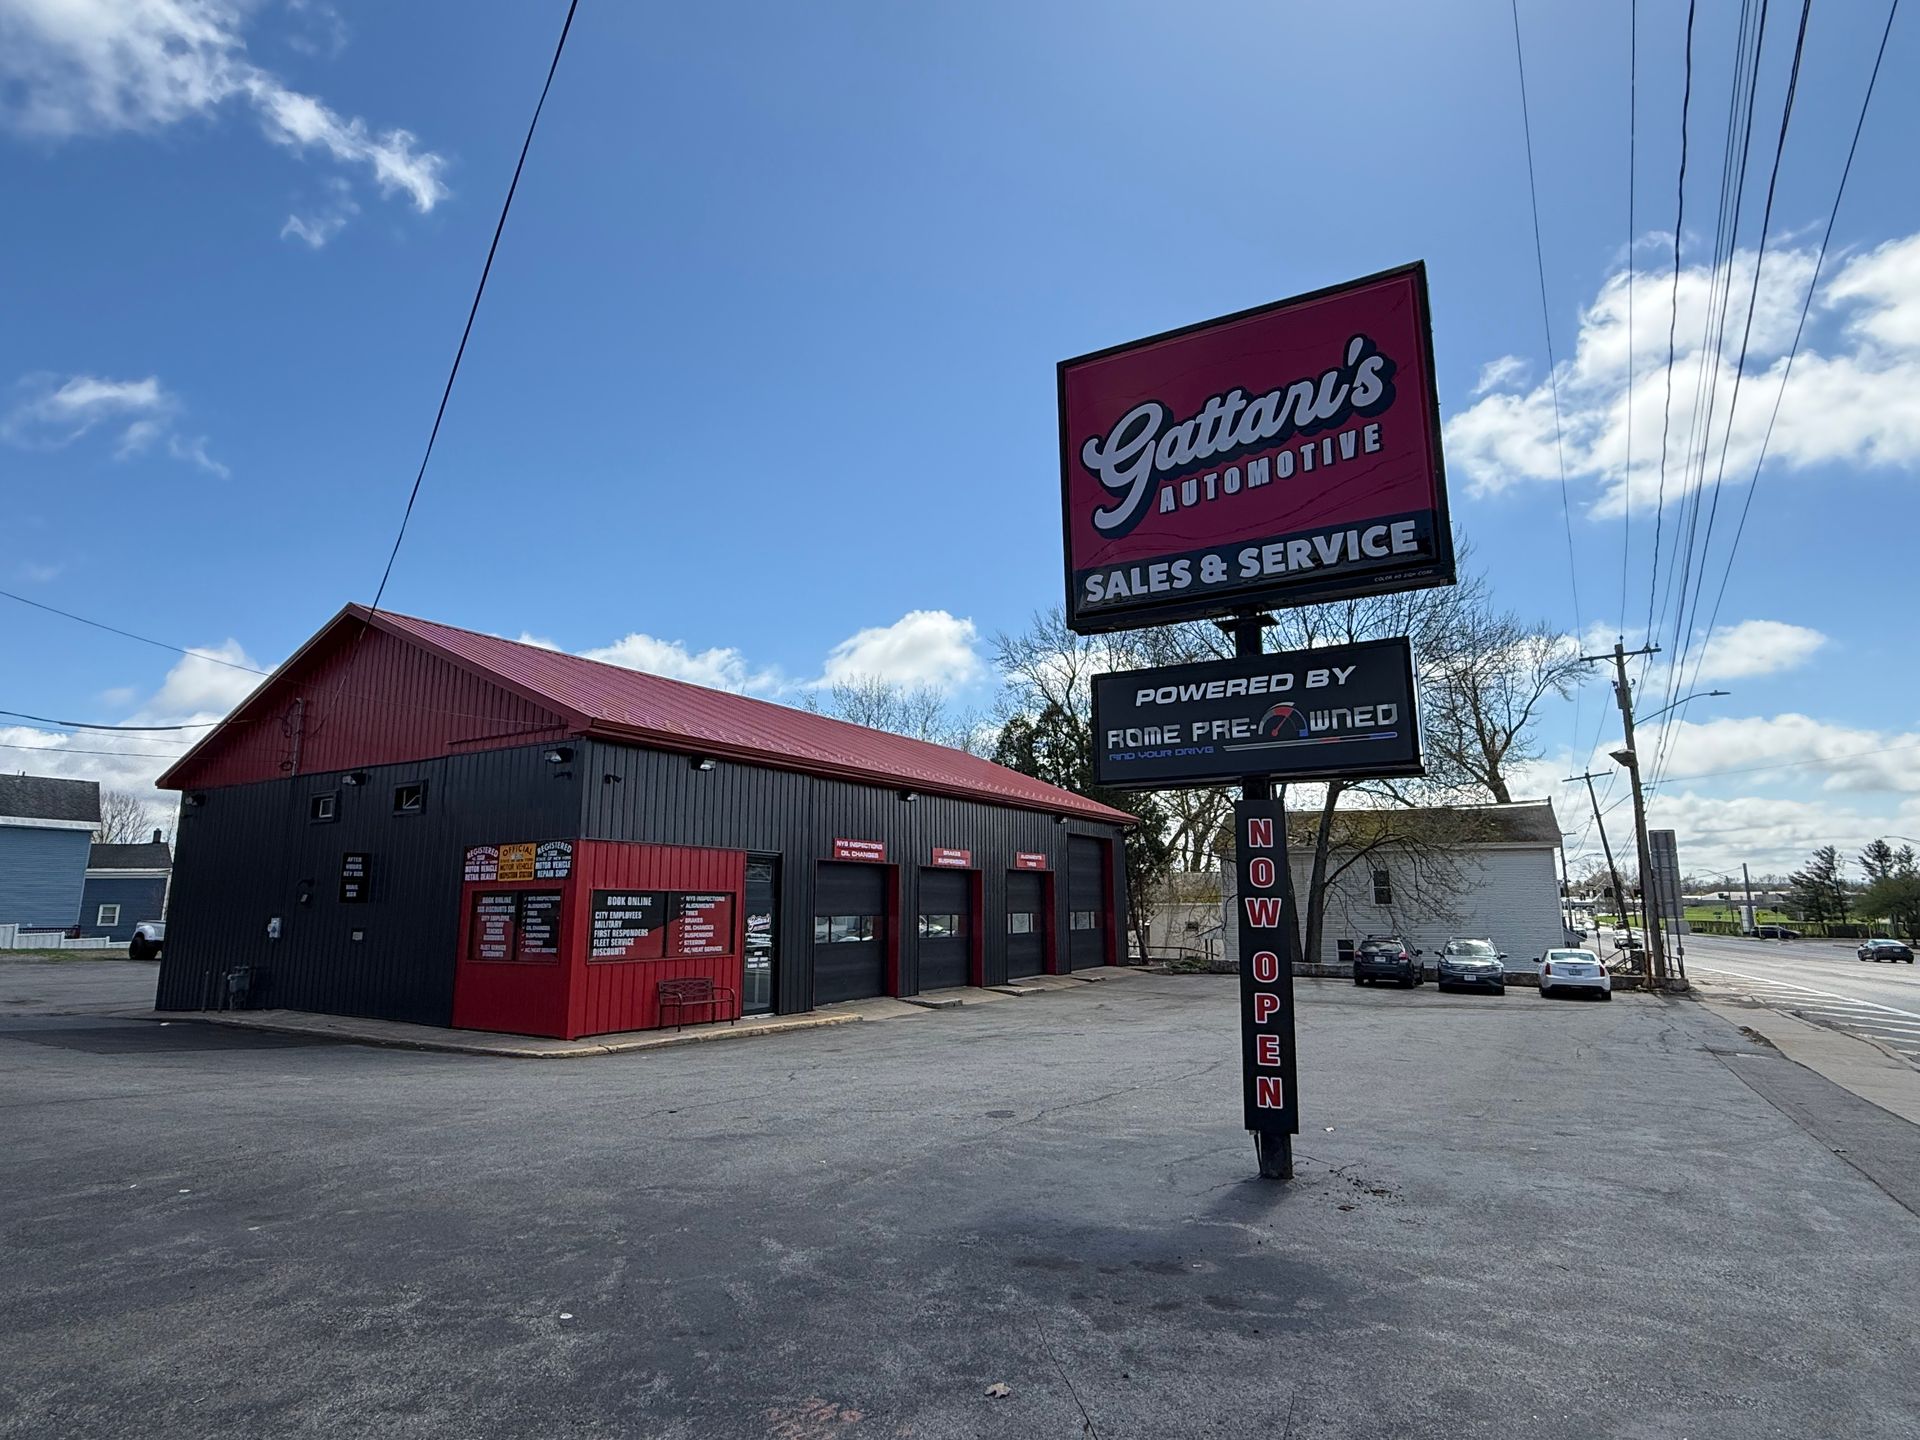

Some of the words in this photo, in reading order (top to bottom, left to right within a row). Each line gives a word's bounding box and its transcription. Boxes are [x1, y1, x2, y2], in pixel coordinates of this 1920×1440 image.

[1158, 422, 1382, 514] AUTOMOTIVE
[1085, 558, 1193, 602] SALES
[1199, 553, 1228, 583] &
[1238, 519, 1418, 579] SERVICE
[1135, 672, 1294, 707] POWERED
[1305, 665, 1357, 689] BY
[1107, 724, 1181, 749] ROME
[1138, 749, 1172, 759] YOUR
[467, 846, 498, 860] REGISTERED
[502, 844, 533, 856] OFFICIAL
[537, 841, 572, 855] REGISTERED
[1245, 818, 1282, 928] NOW
[607, 896, 626, 906] BOOK
[627, 896, 652, 906] ONLINE
[595, 911, 609, 919] CITY
[610, 911, 642, 920] EMPLOYEES
[594, 920, 623, 928] MILITARY
[594, 929, 611, 938] FIRST
[612, 929, 649, 938] RESPONDERS
[594, 938, 610, 946] FLEET
[610, 938, 634, 946] SERVICE
[592, 946, 626, 956] DISCOUNTS
[1253, 951, 1284, 1110] OPEN
